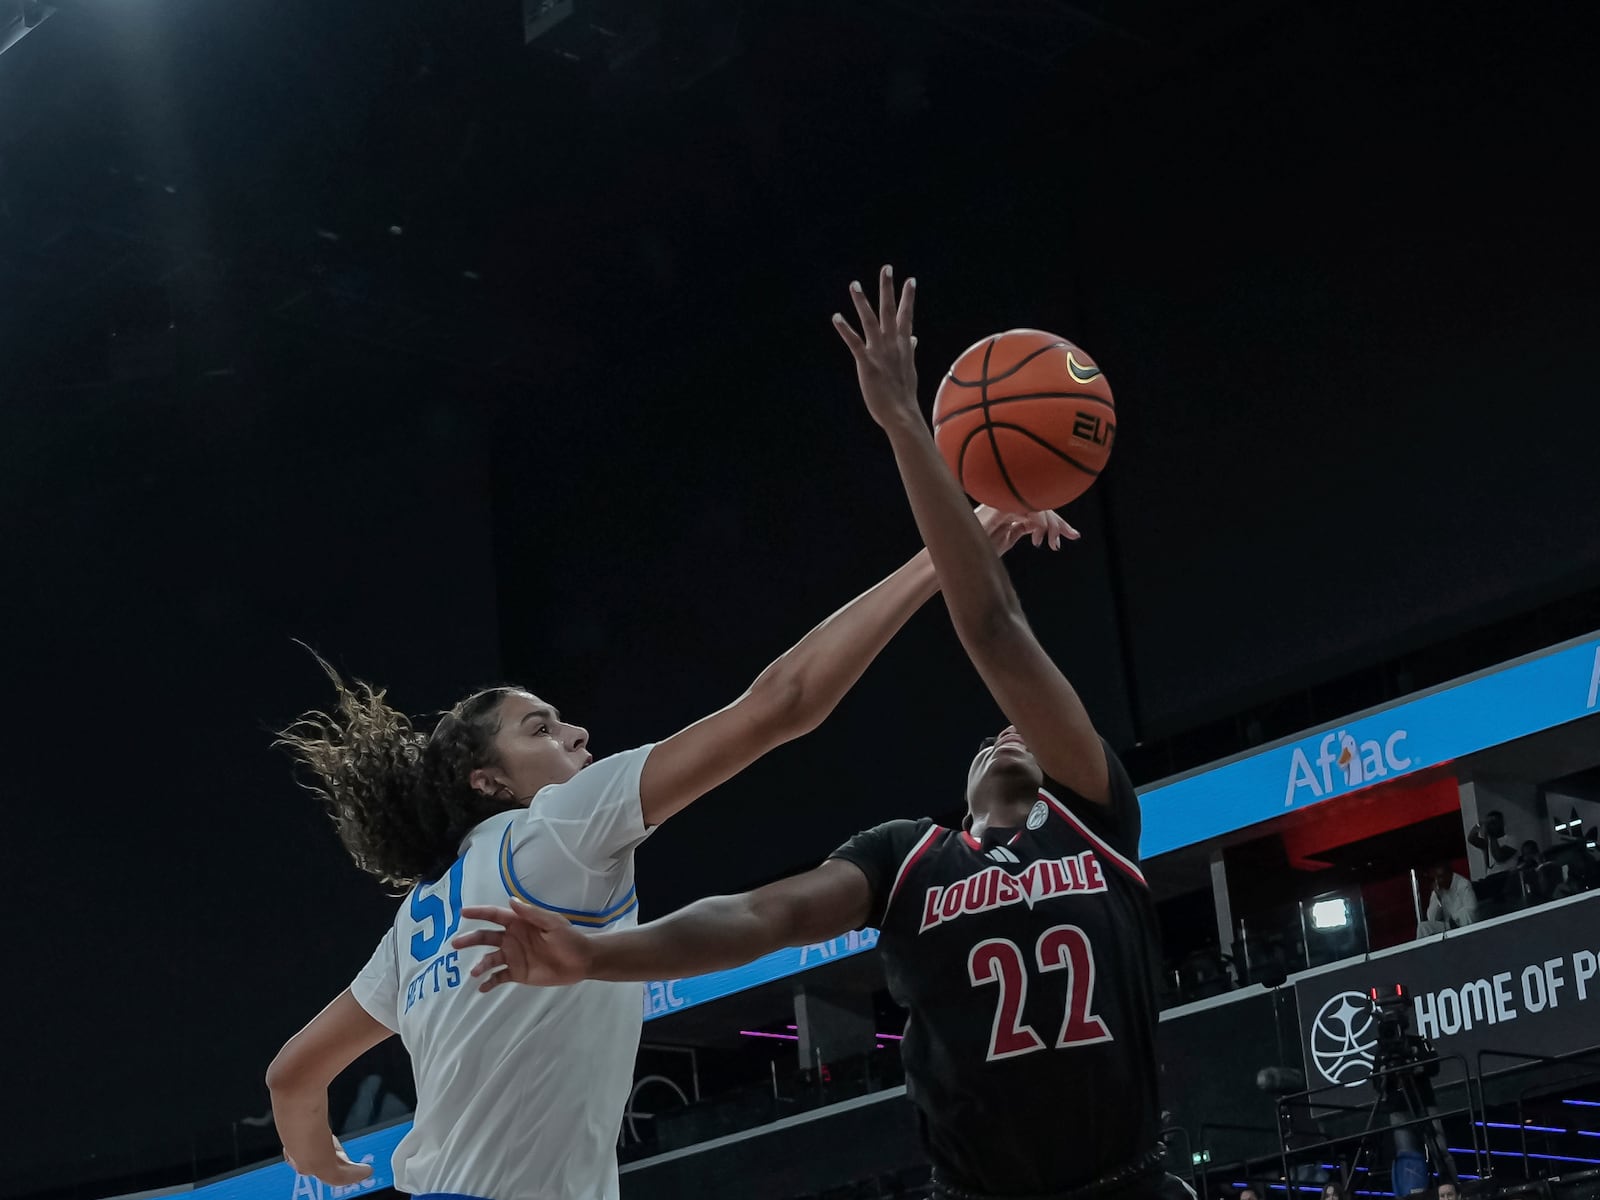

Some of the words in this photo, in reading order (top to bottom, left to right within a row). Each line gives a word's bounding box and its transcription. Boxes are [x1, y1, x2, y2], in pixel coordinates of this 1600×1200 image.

[919, 850, 1109, 935] LOUISVILLE
[967, 924, 1114, 1062] 22
[1414, 971, 1517, 1040] HOME
[1521, 956, 1565, 1014] OF
[1573, 949, 1600, 1001] P
